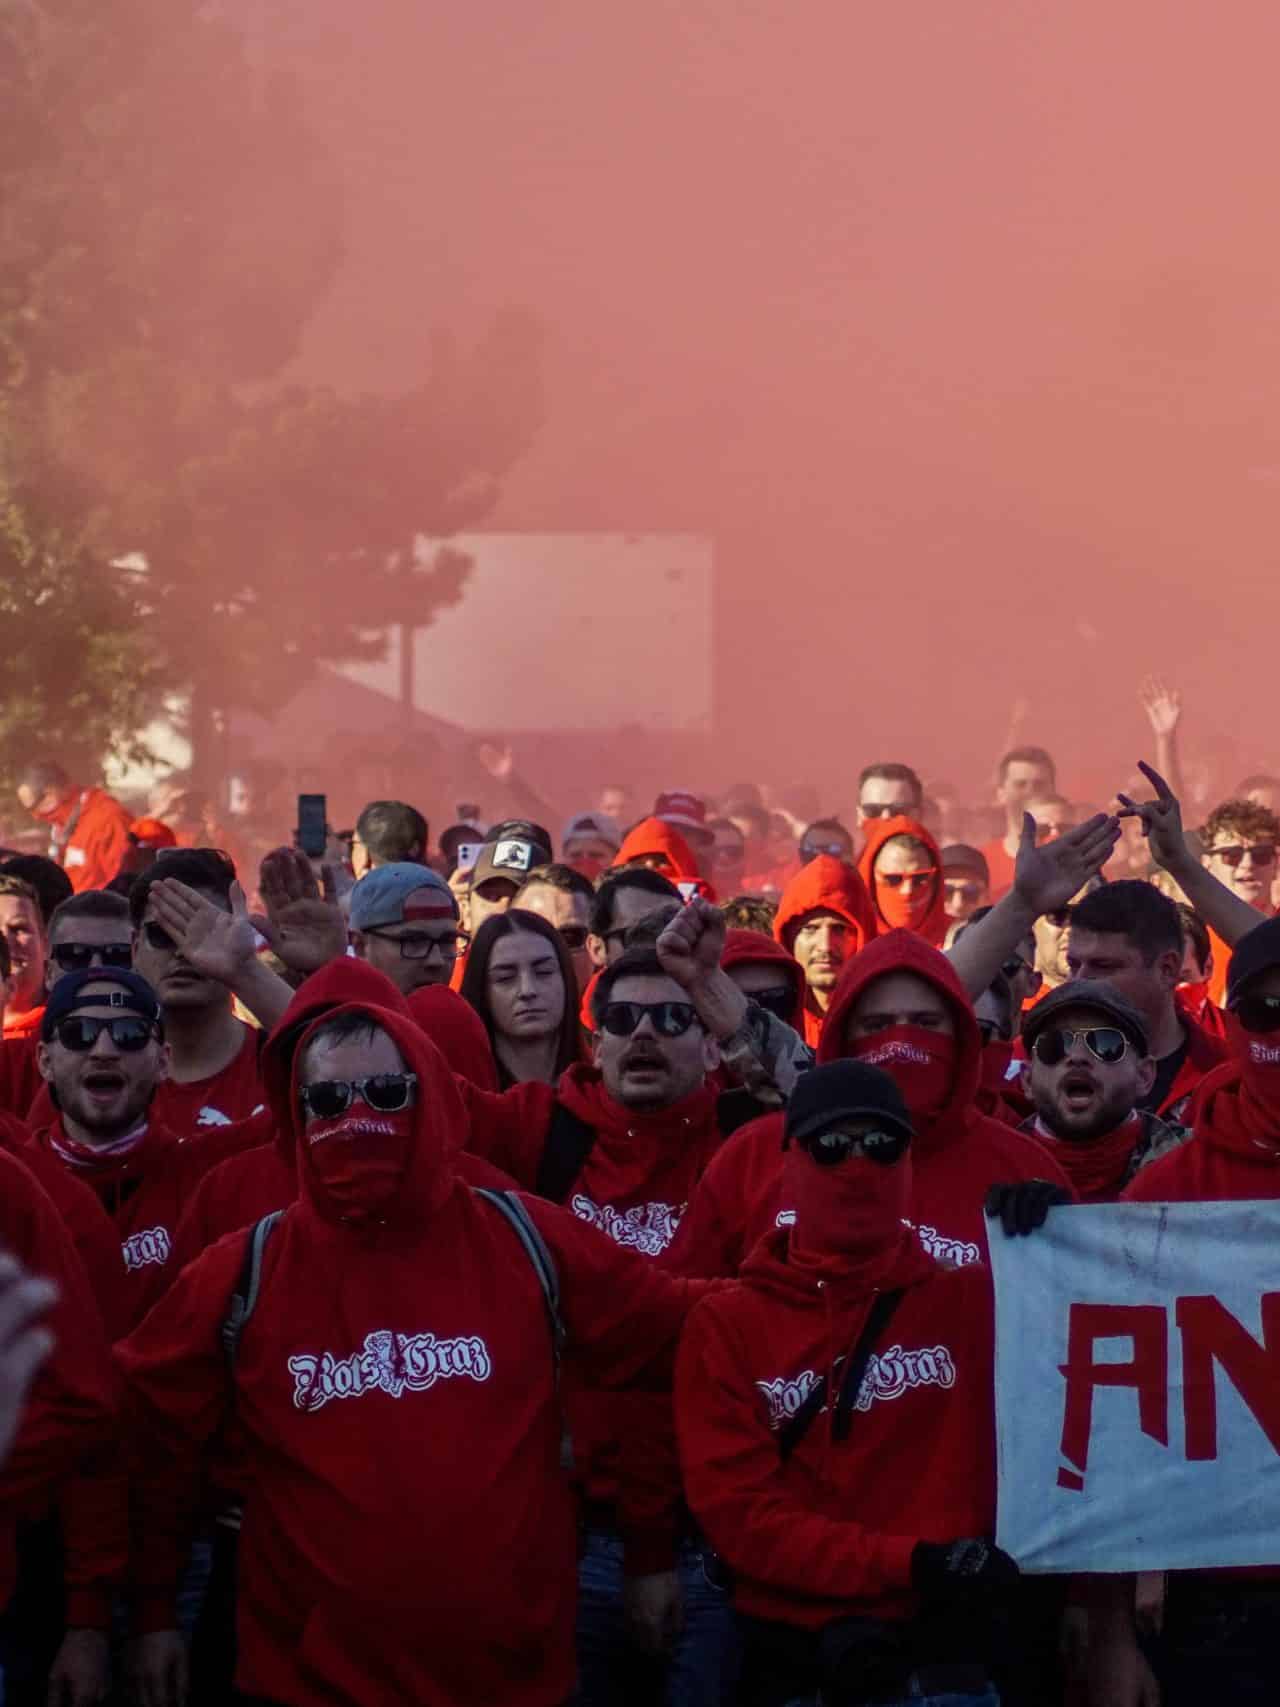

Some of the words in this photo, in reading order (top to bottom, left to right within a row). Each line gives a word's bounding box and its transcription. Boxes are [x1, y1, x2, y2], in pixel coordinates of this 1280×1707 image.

[121, 1225, 171, 1272] raz
[402, 1333, 491, 1393] Graz
[870, 1344, 956, 1401] Graz
